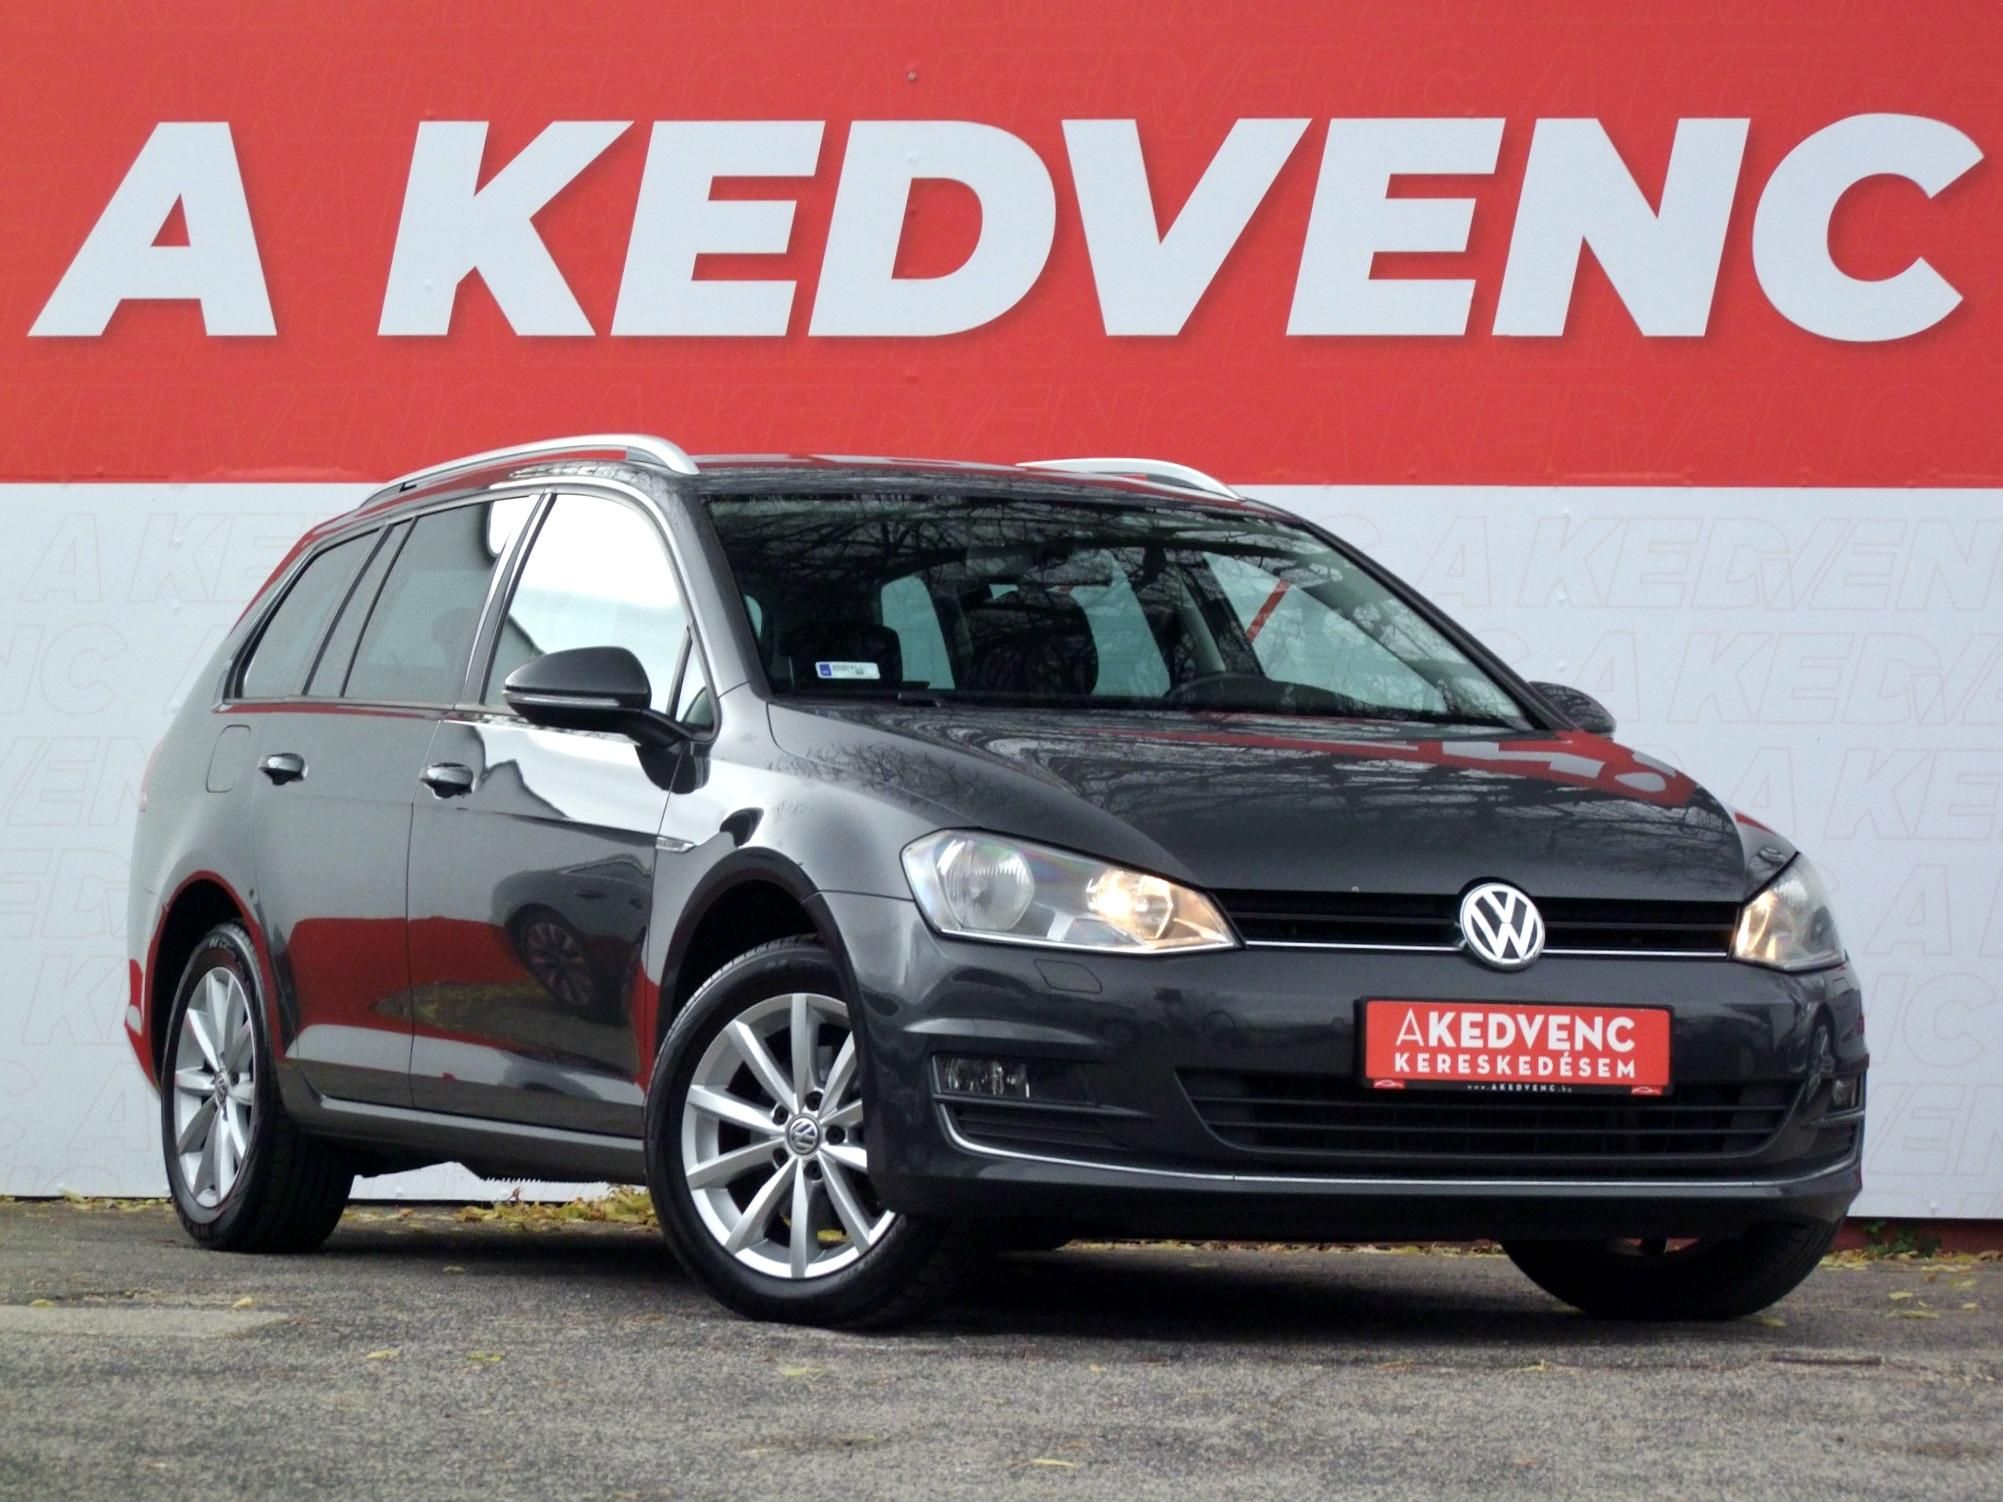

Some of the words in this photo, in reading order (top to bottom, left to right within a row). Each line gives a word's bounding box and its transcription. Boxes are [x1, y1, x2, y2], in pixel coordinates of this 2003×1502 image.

[28, 121, 277, 337] A
[377, 113, 1985, 342] KEDVENC
[1395, 1051, 1636, 1078] KERESKEDÉSEM
